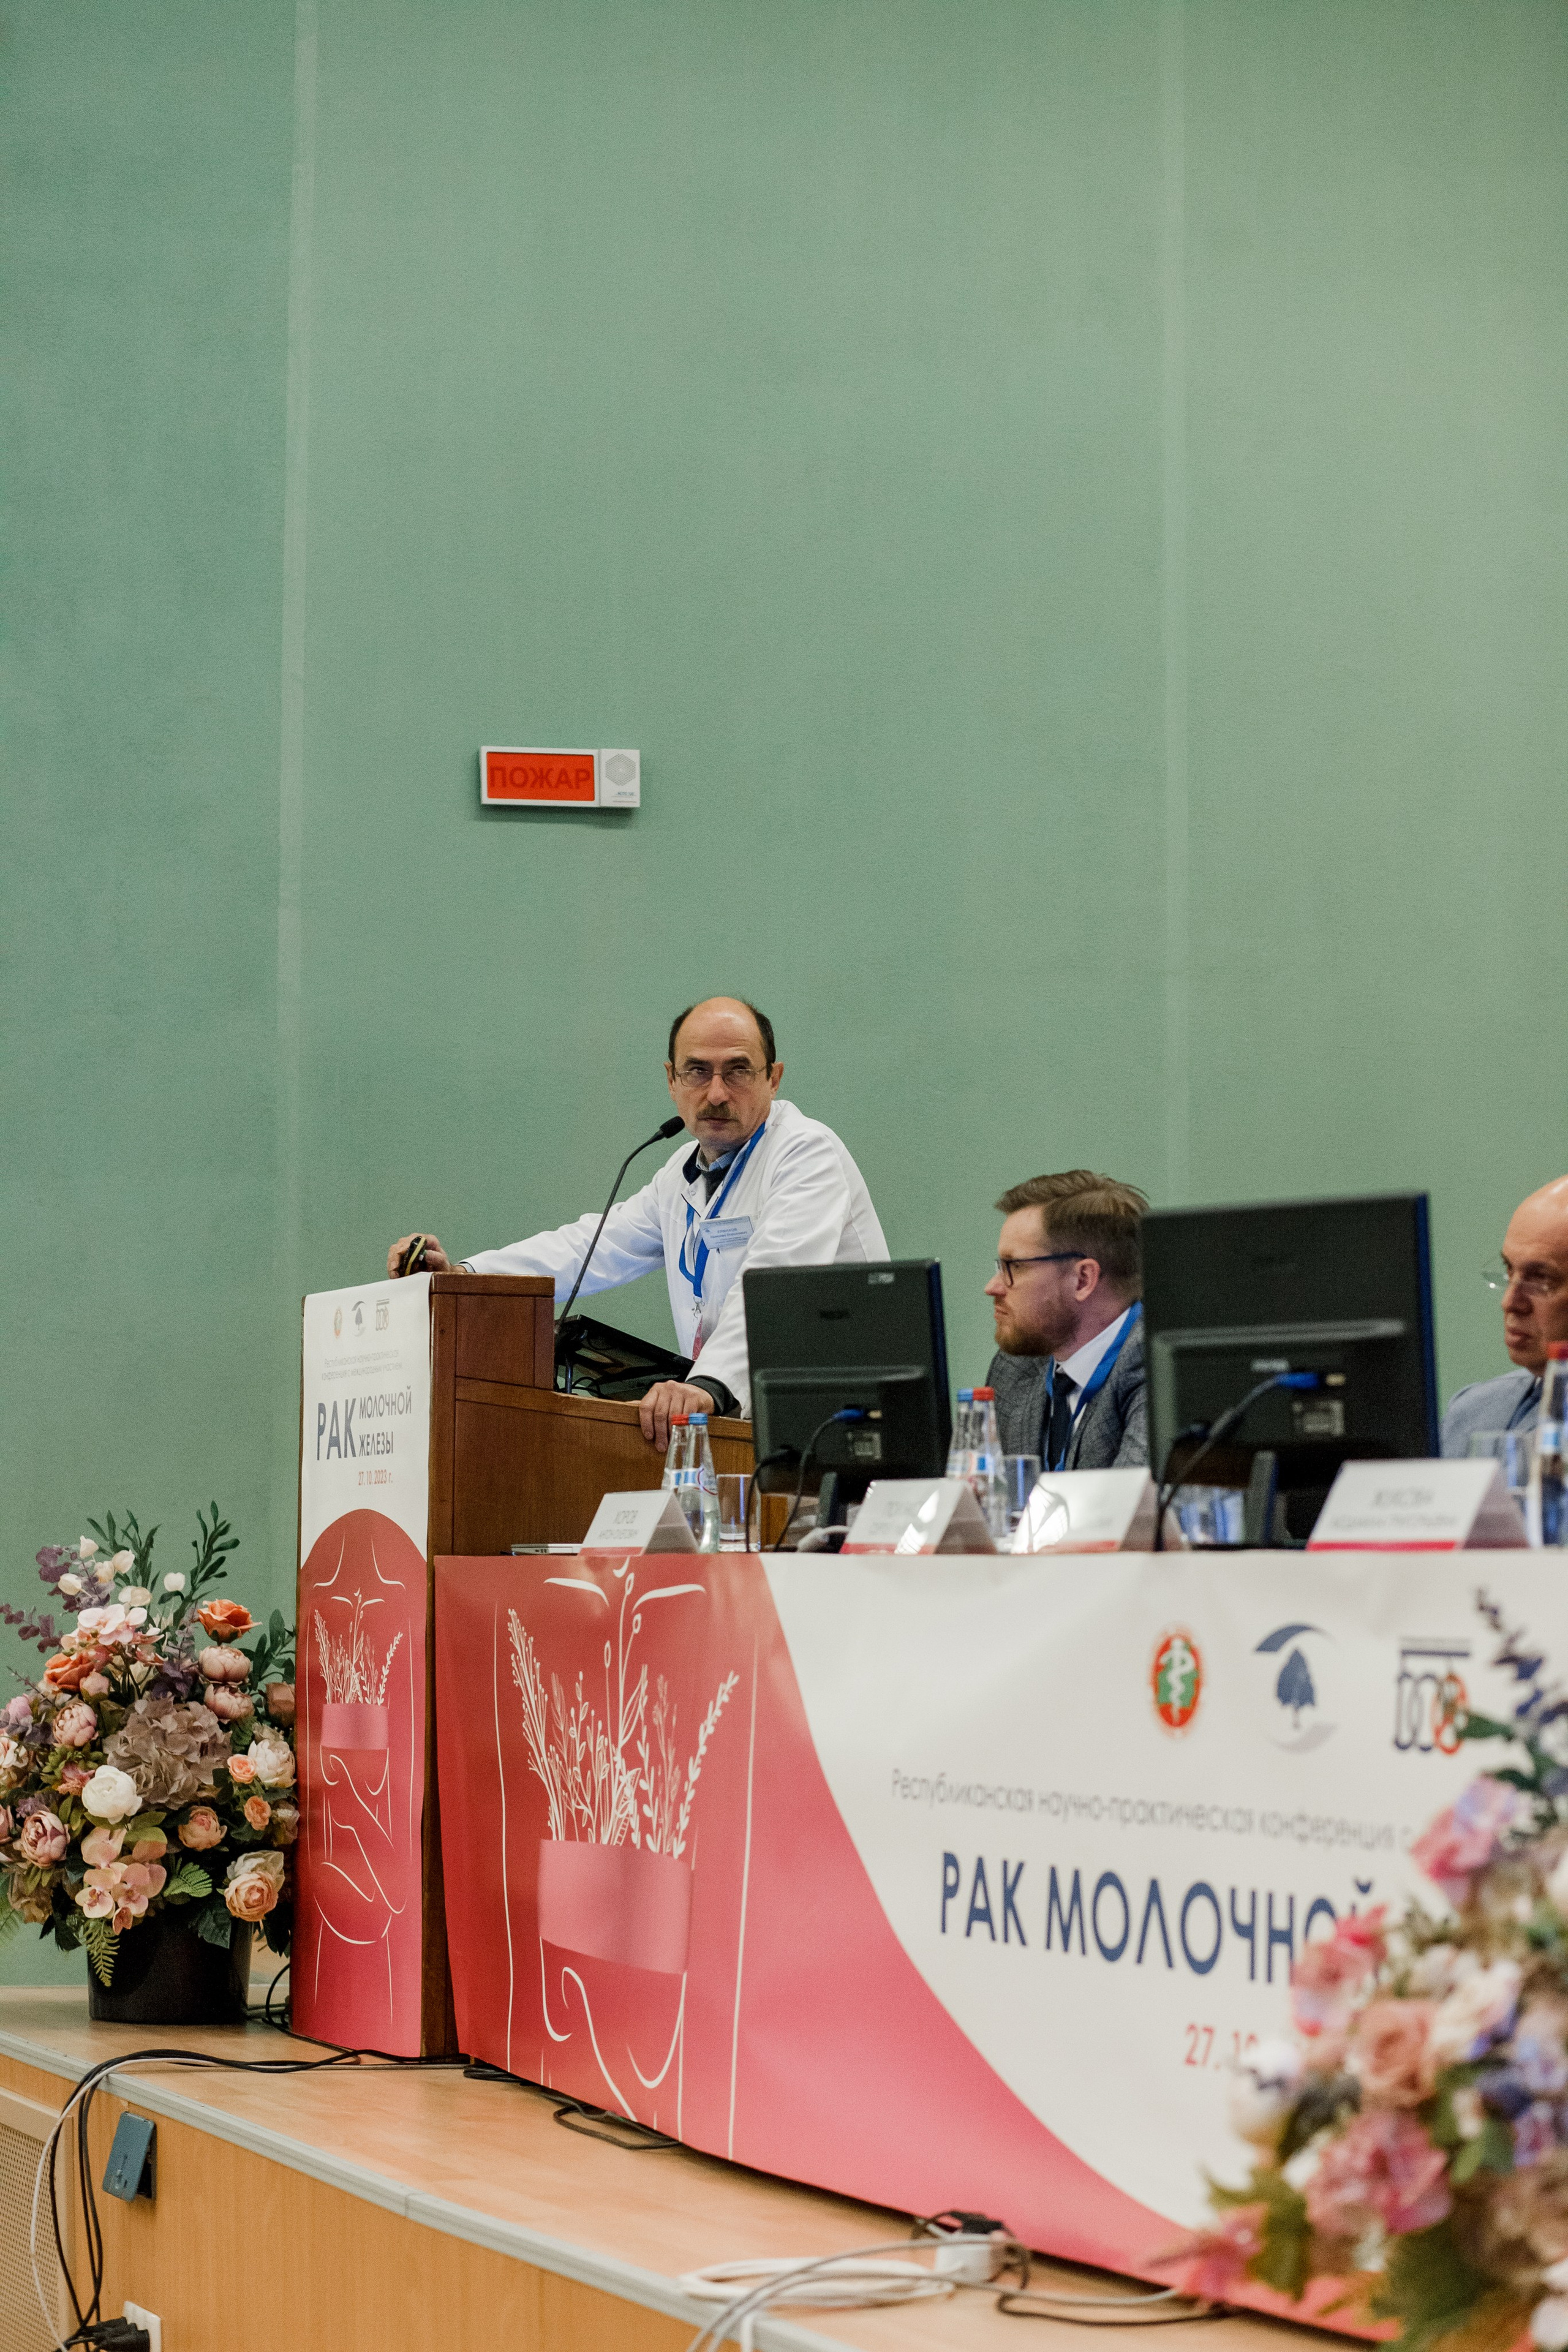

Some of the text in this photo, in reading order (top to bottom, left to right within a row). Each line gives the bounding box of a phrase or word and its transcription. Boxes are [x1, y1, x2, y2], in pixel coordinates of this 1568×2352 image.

[489, 766, 590, 790] ПОЖАР
[317, 1385, 412, 1461] РАК МОЛОЧНОЙ
[359, 1431, 393, 1457] ЖЕЛЕЗЫ
[374, 1469, 387, 1485] 2023
[892, 1767, 1034, 1812] Республиканская
[1038, 1790, 1254, 1834] научно-практическая
[1260, 1808, 1395, 1851] конференция
[940, 1851, 1376, 1986] РАК МОЛОЧН
